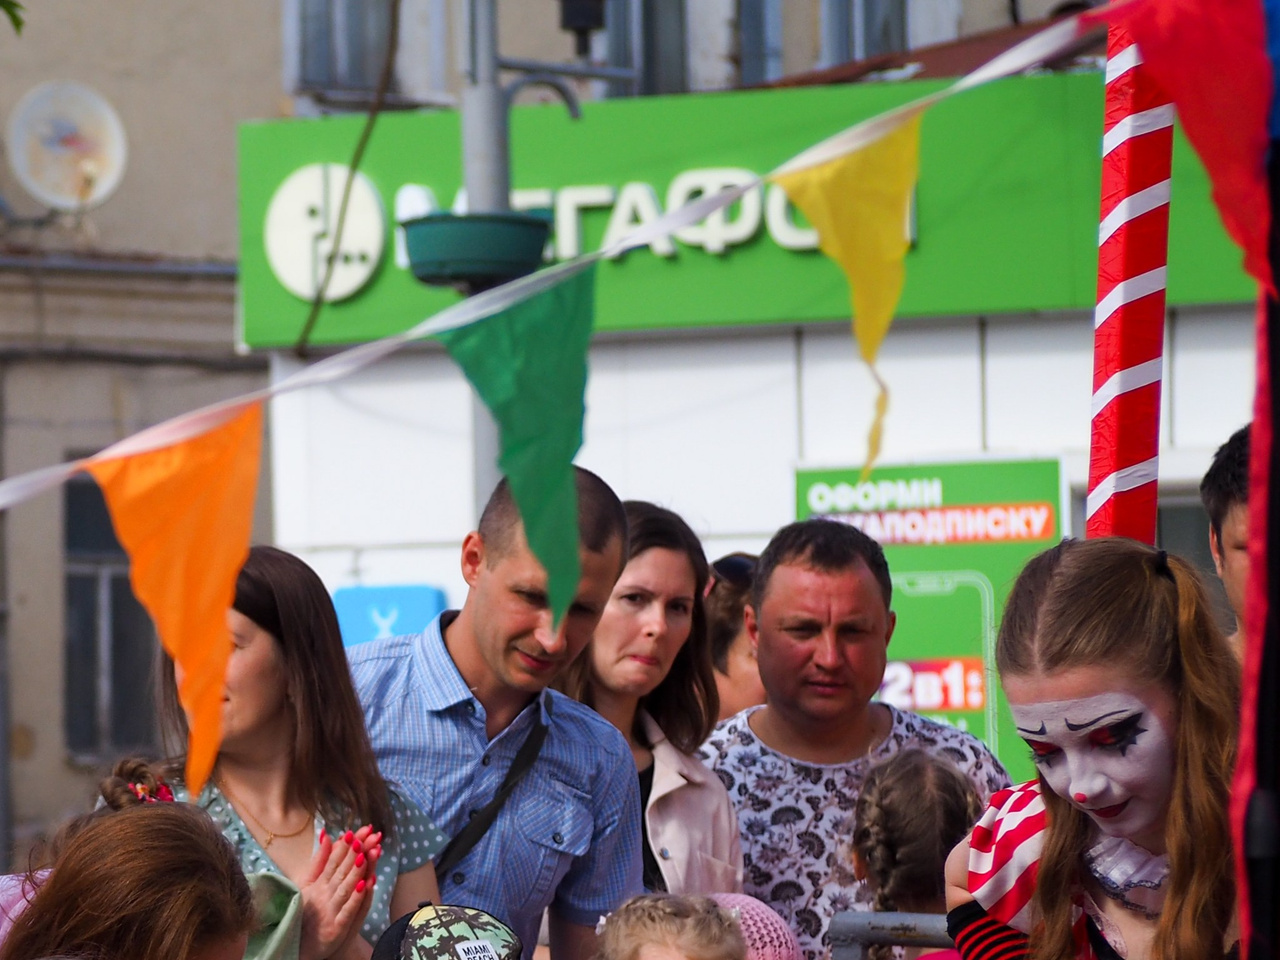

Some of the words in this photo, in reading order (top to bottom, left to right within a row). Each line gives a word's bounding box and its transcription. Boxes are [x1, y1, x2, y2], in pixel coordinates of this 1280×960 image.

[395, 167, 917, 269] ГАФО
[807, 477, 942, 513] ОФОРМИ
[814, 506, 1049, 545] АПОДПИСКУ
[461, 944, 491, 957] MIAMI
